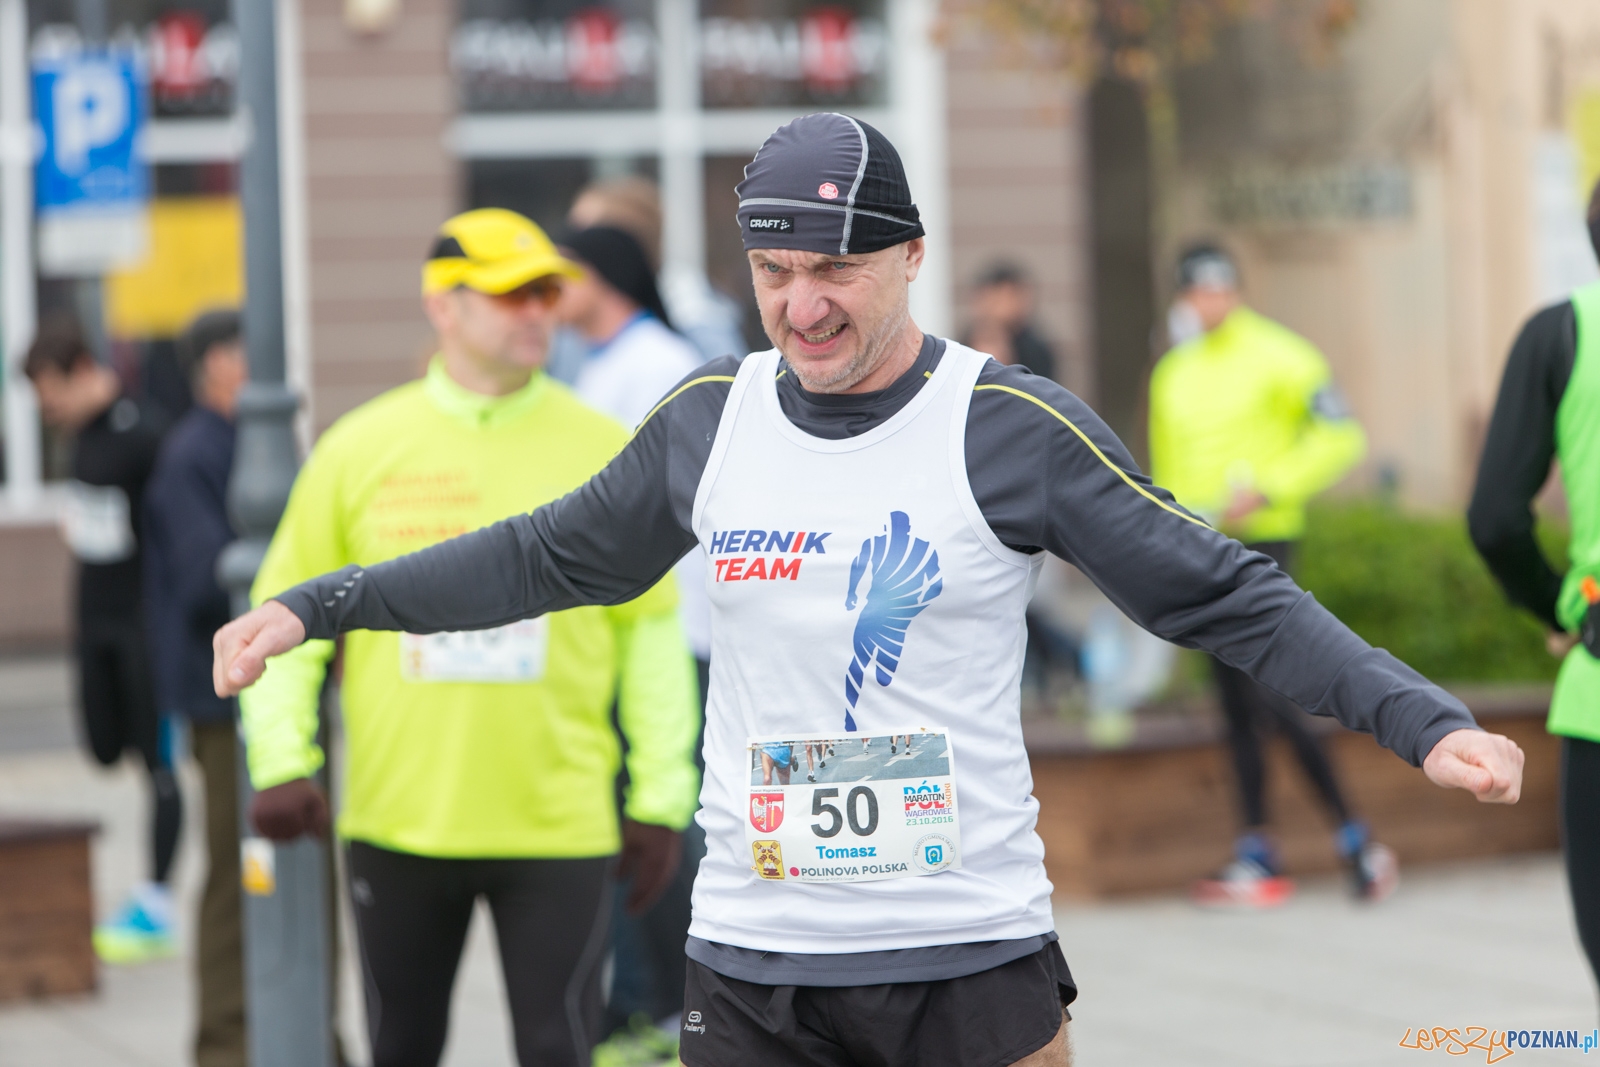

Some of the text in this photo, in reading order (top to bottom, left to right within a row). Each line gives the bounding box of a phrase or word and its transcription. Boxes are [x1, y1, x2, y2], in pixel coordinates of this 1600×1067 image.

[749, 218, 780, 228] CRAFT
[709, 529, 833, 555] HERNIK
[714, 557, 803, 582] TEAM
[904, 793, 945, 803] MARATON
[810, 785, 879, 839] 50
[904, 808, 953, 818] WĄGROWIEC
[906, 815, 954, 826] 23.10.2016
[815, 845, 877, 860] Tomasz
[801, 866, 860, 877] POLINOVA
[862, 862, 908, 875] POLSKA
